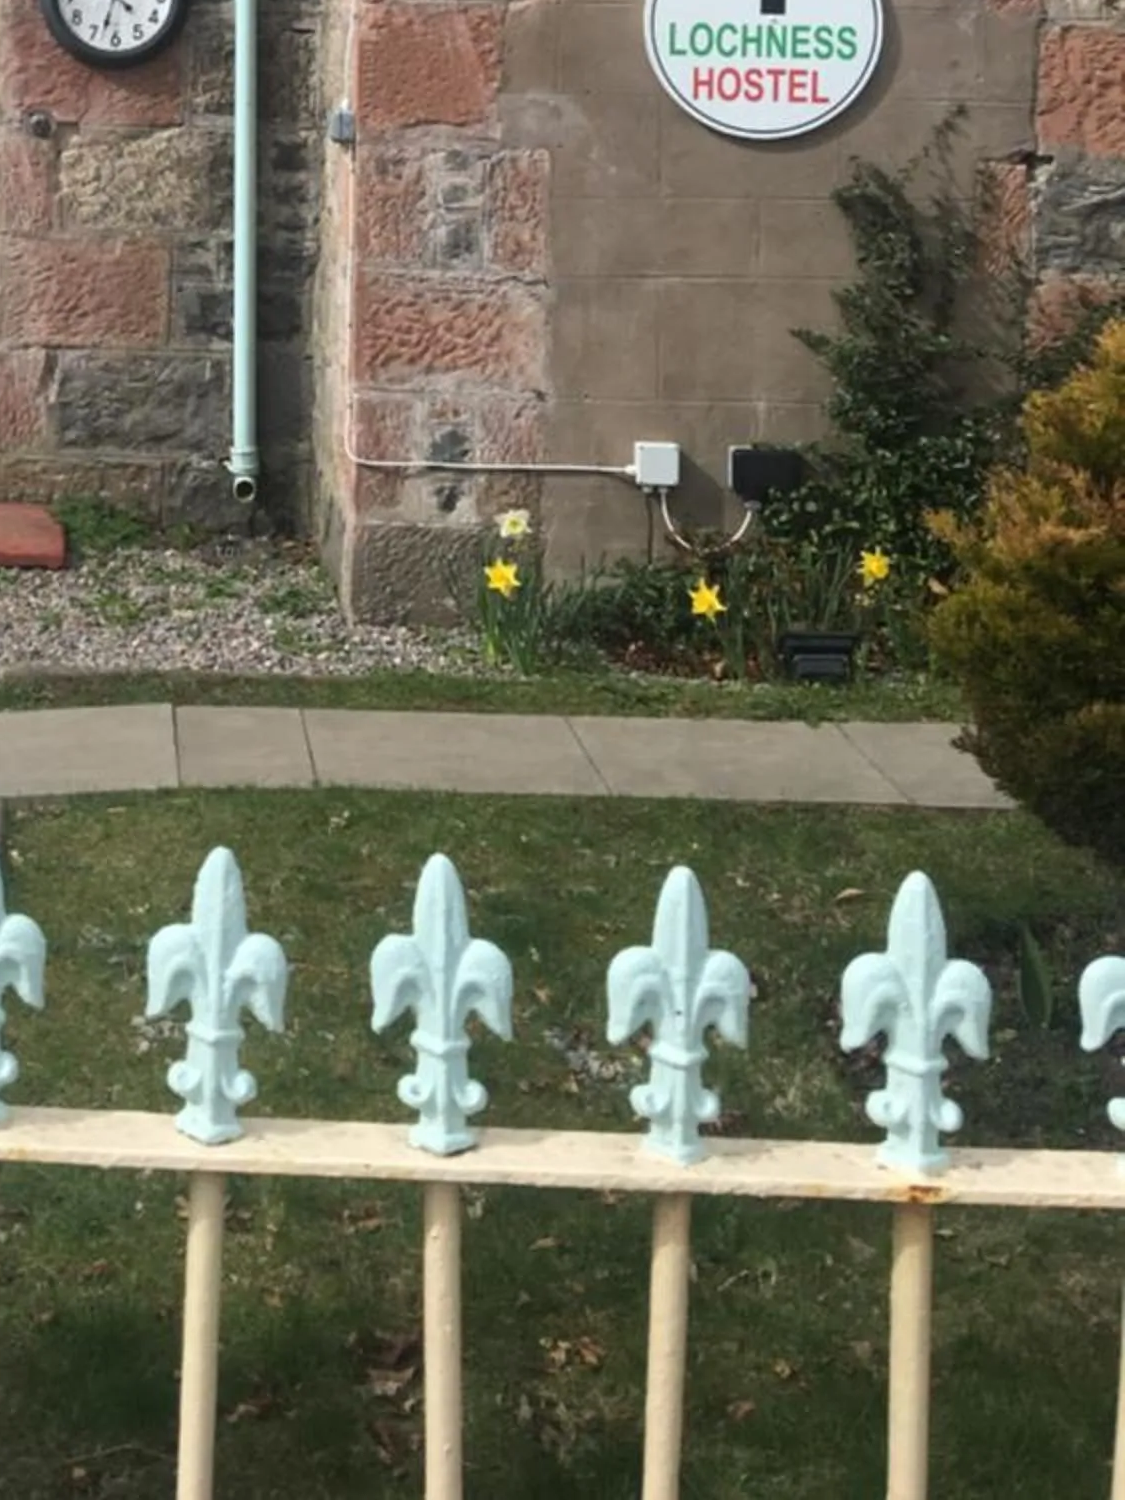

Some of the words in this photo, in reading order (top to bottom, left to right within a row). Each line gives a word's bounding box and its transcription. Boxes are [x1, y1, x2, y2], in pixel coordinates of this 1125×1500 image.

[72, 9, 83, 26] 8
[148, 9, 159, 24] 4
[89, 24, 100, 40] 7
[110, 29, 122, 47] 6
[132, 23, 144, 40] 5
[668, 22, 858, 61] LOCHNESS
[692, 67, 830, 104] HOSTEL
